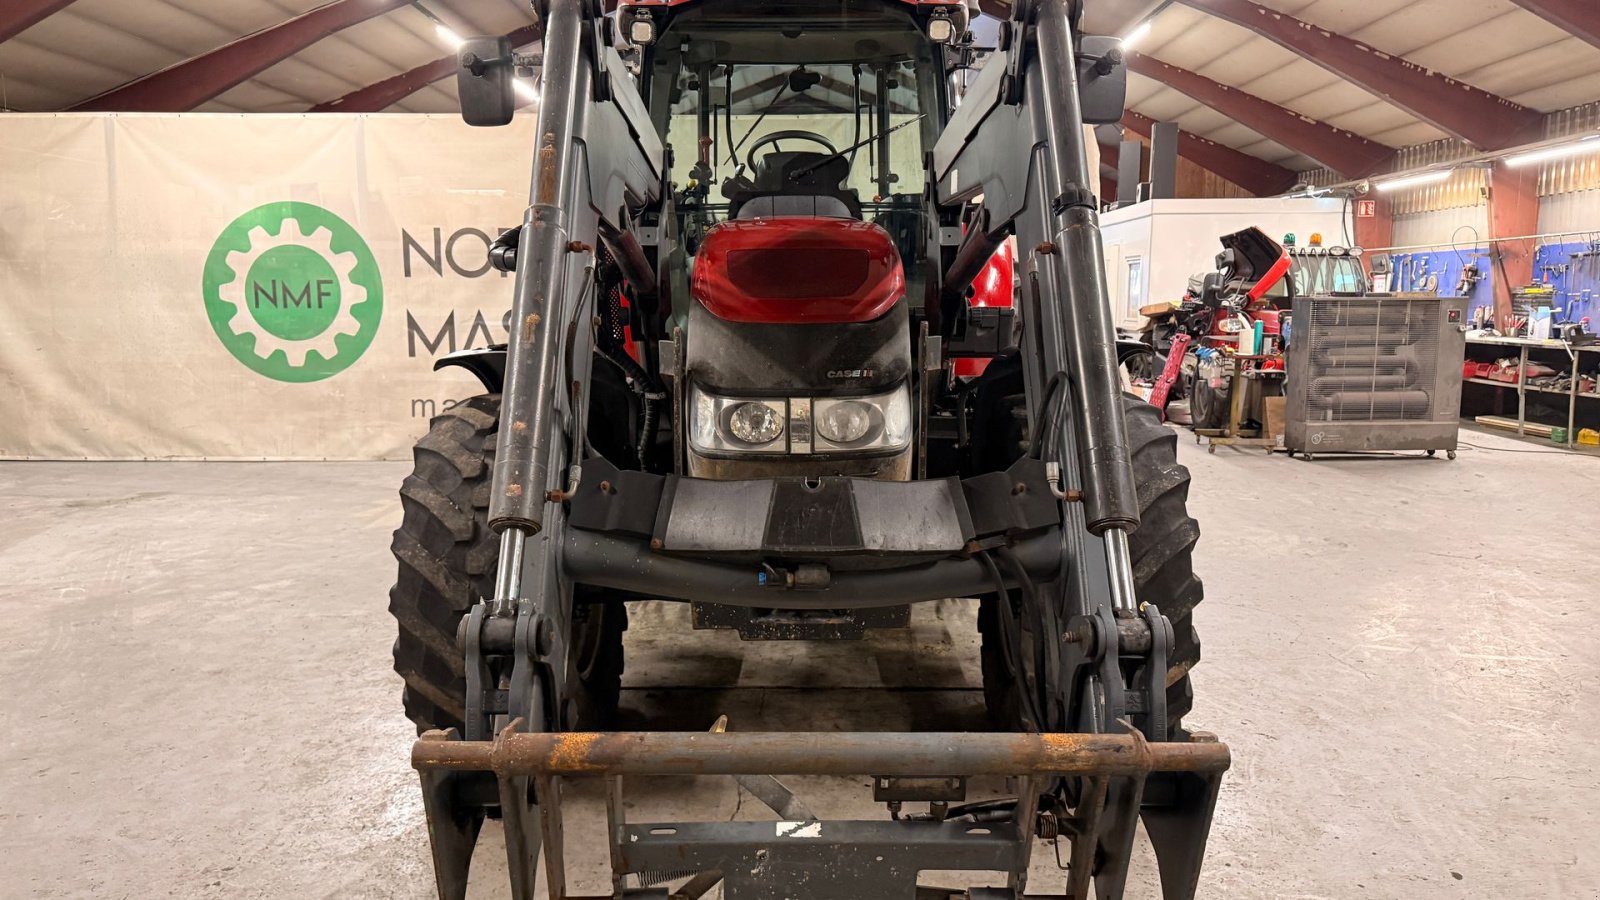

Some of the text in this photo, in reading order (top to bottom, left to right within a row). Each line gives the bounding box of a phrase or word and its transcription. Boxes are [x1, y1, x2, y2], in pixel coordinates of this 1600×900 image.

[401, 227, 513, 278] NO
[253, 279, 333, 309] NMF
[827, 369, 861, 378] CASE
